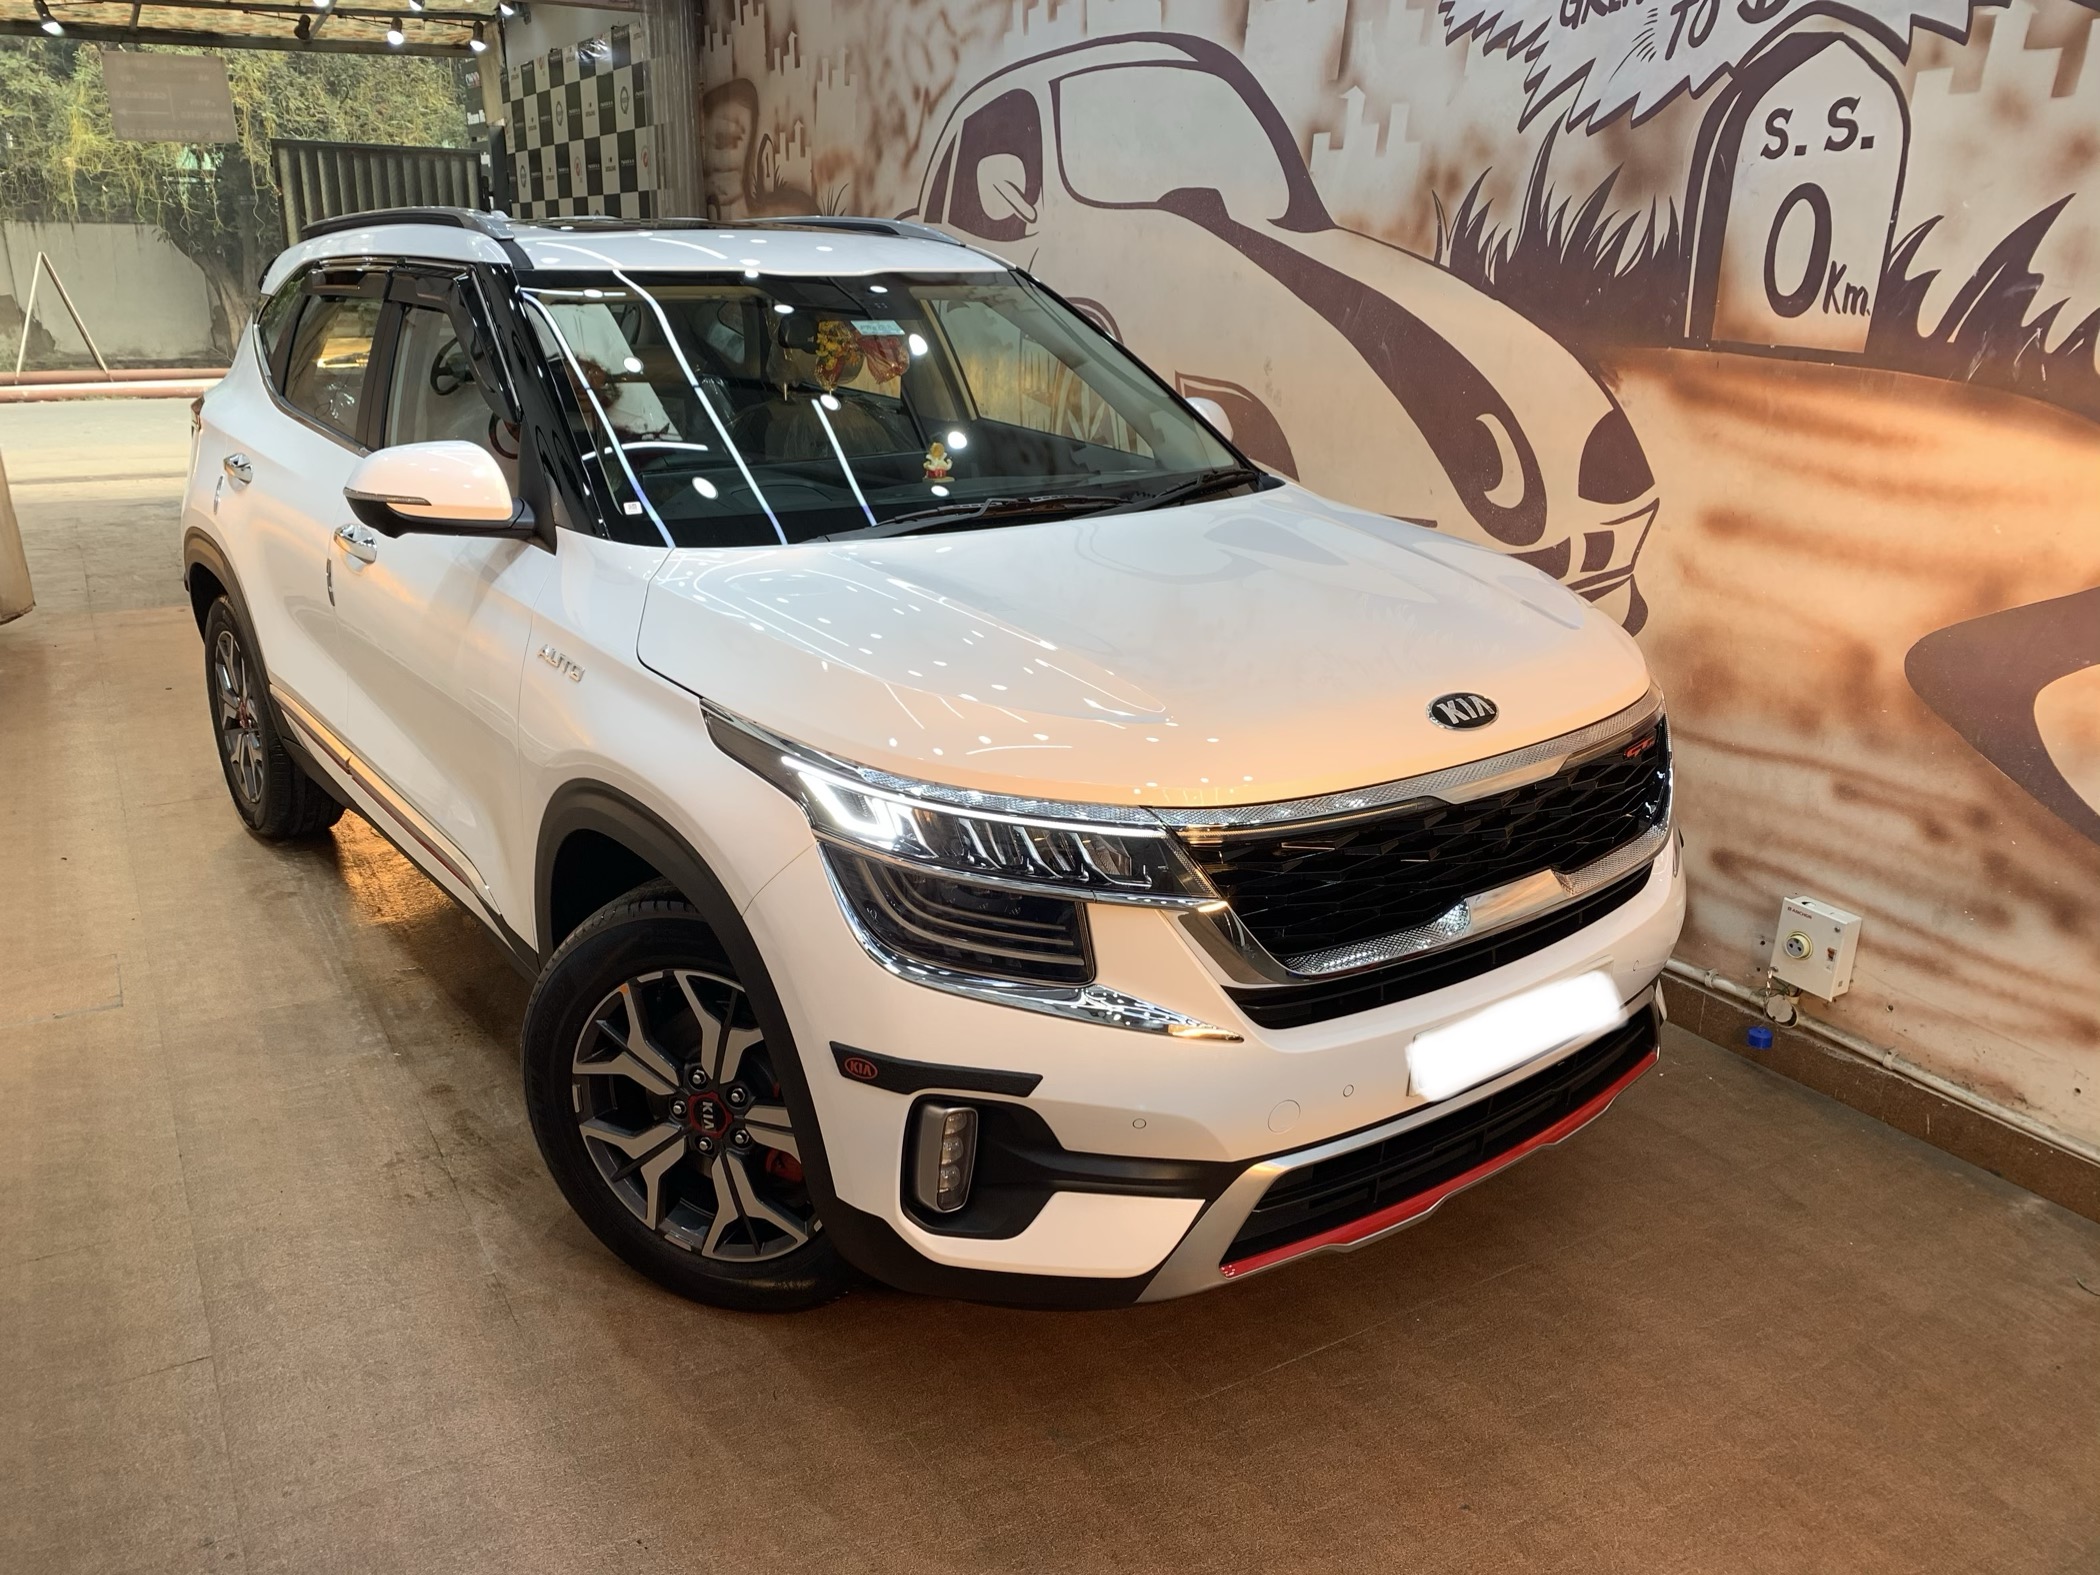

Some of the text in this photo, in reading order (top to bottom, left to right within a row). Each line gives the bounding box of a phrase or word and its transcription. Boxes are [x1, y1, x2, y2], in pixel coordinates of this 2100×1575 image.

[1664, 0, 1720, 61] TO
[1441, 696, 1494, 725] KIA
[850, 1060, 872, 1077] KIA
[702, 1101, 715, 1131] KIA
